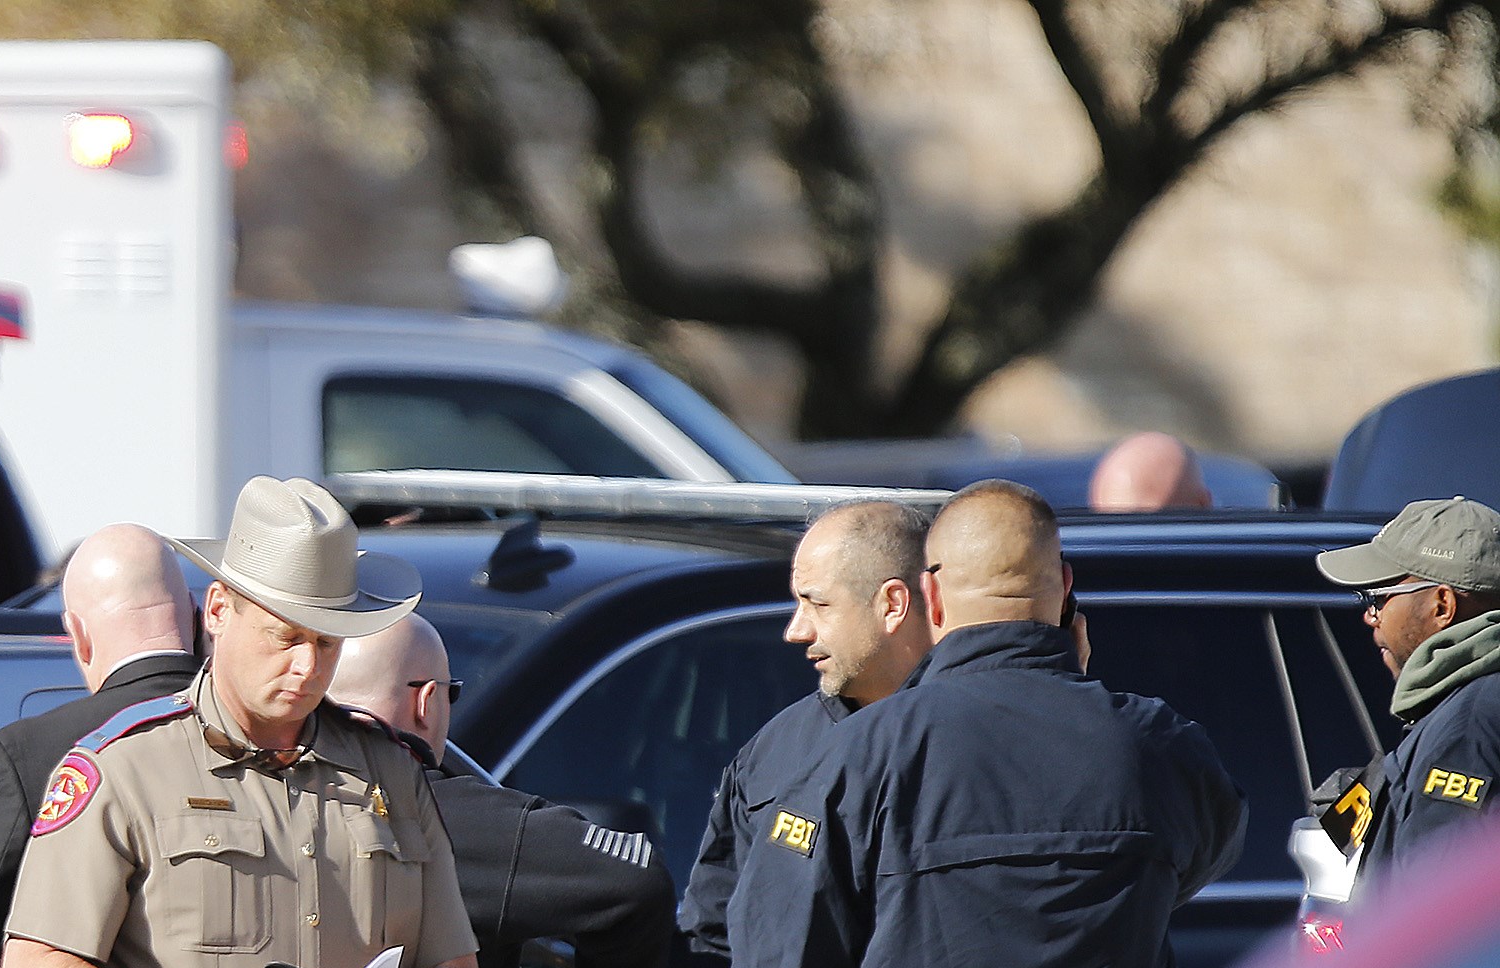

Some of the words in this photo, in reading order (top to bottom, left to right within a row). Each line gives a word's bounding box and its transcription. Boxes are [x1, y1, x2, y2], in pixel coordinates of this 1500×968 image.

[1421, 546, 1455, 560] DALLAS
[1423, 767, 1485, 803] FBI
[771, 810, 817, 851] FBI
